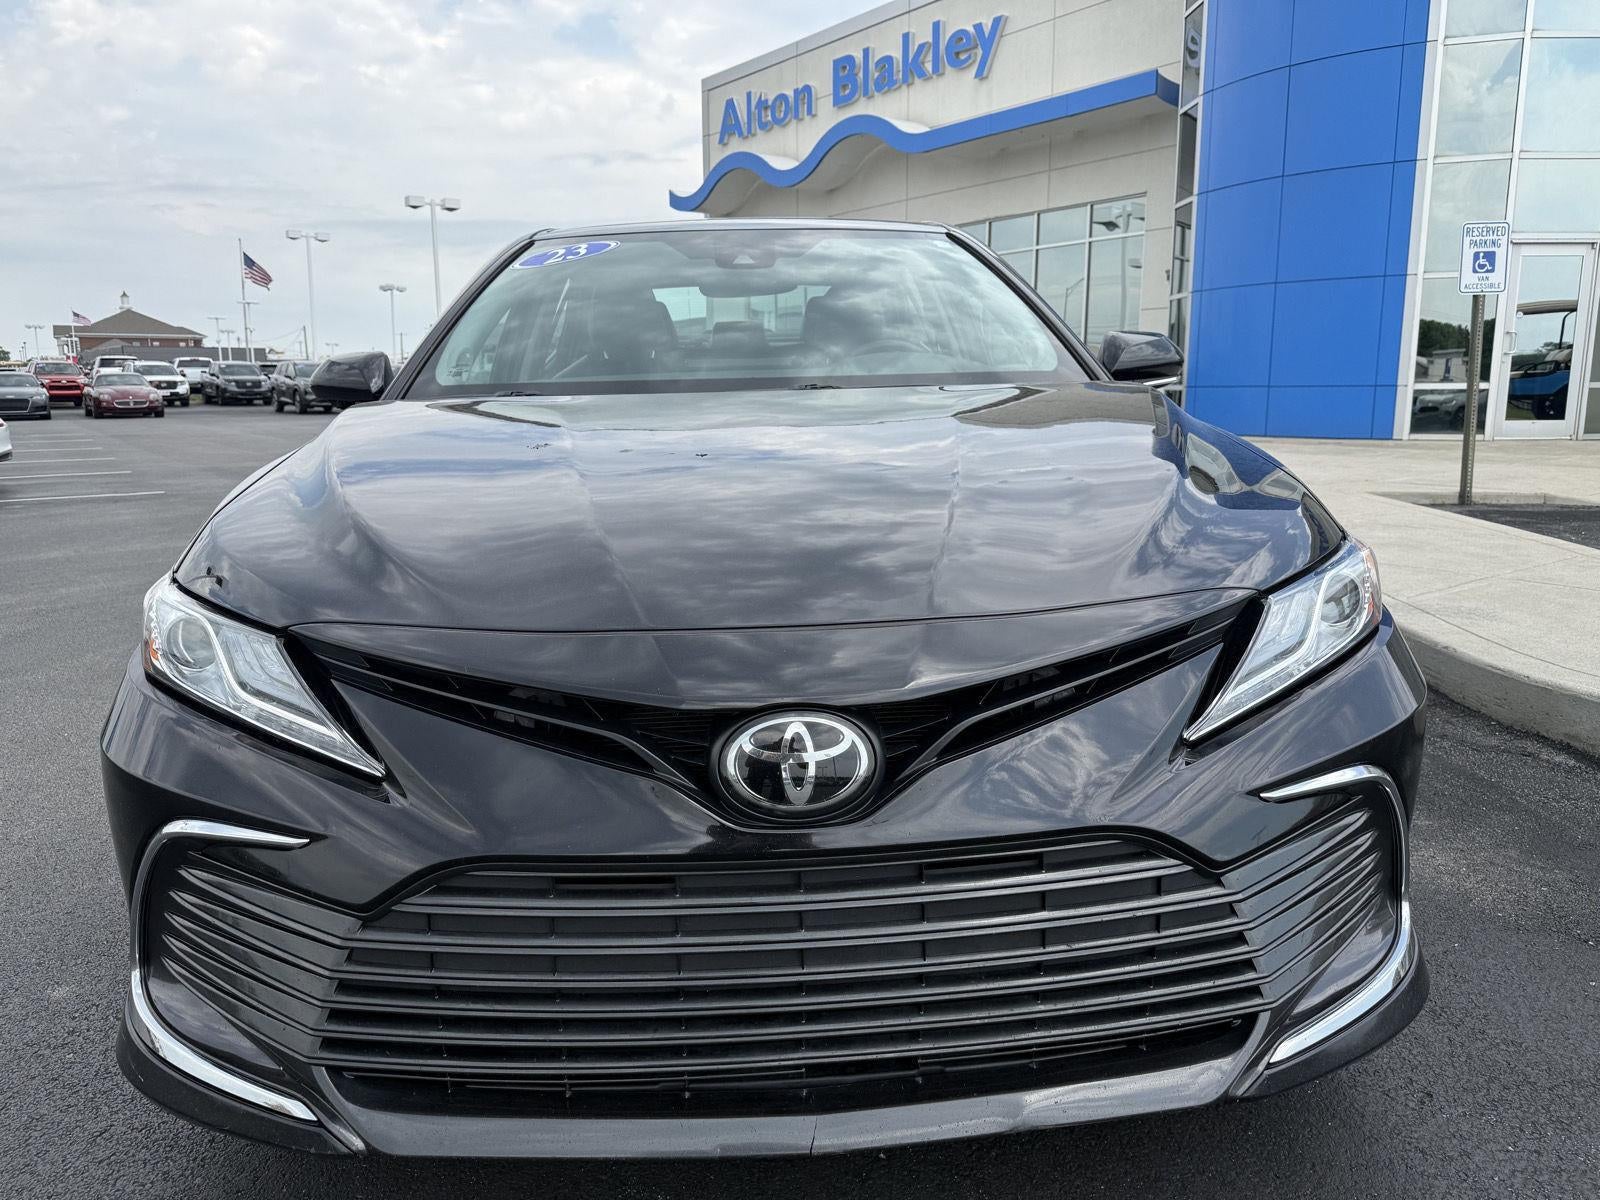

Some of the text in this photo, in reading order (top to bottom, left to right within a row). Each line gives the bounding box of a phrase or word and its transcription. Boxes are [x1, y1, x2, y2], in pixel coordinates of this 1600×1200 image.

[718, 15, 1005, 145] Alton Blakley
[1466, 226, 1506, 237] RESERVED
[1469, 239, 1501, 249] PARKING
[543, 243, 589, 265] 23
